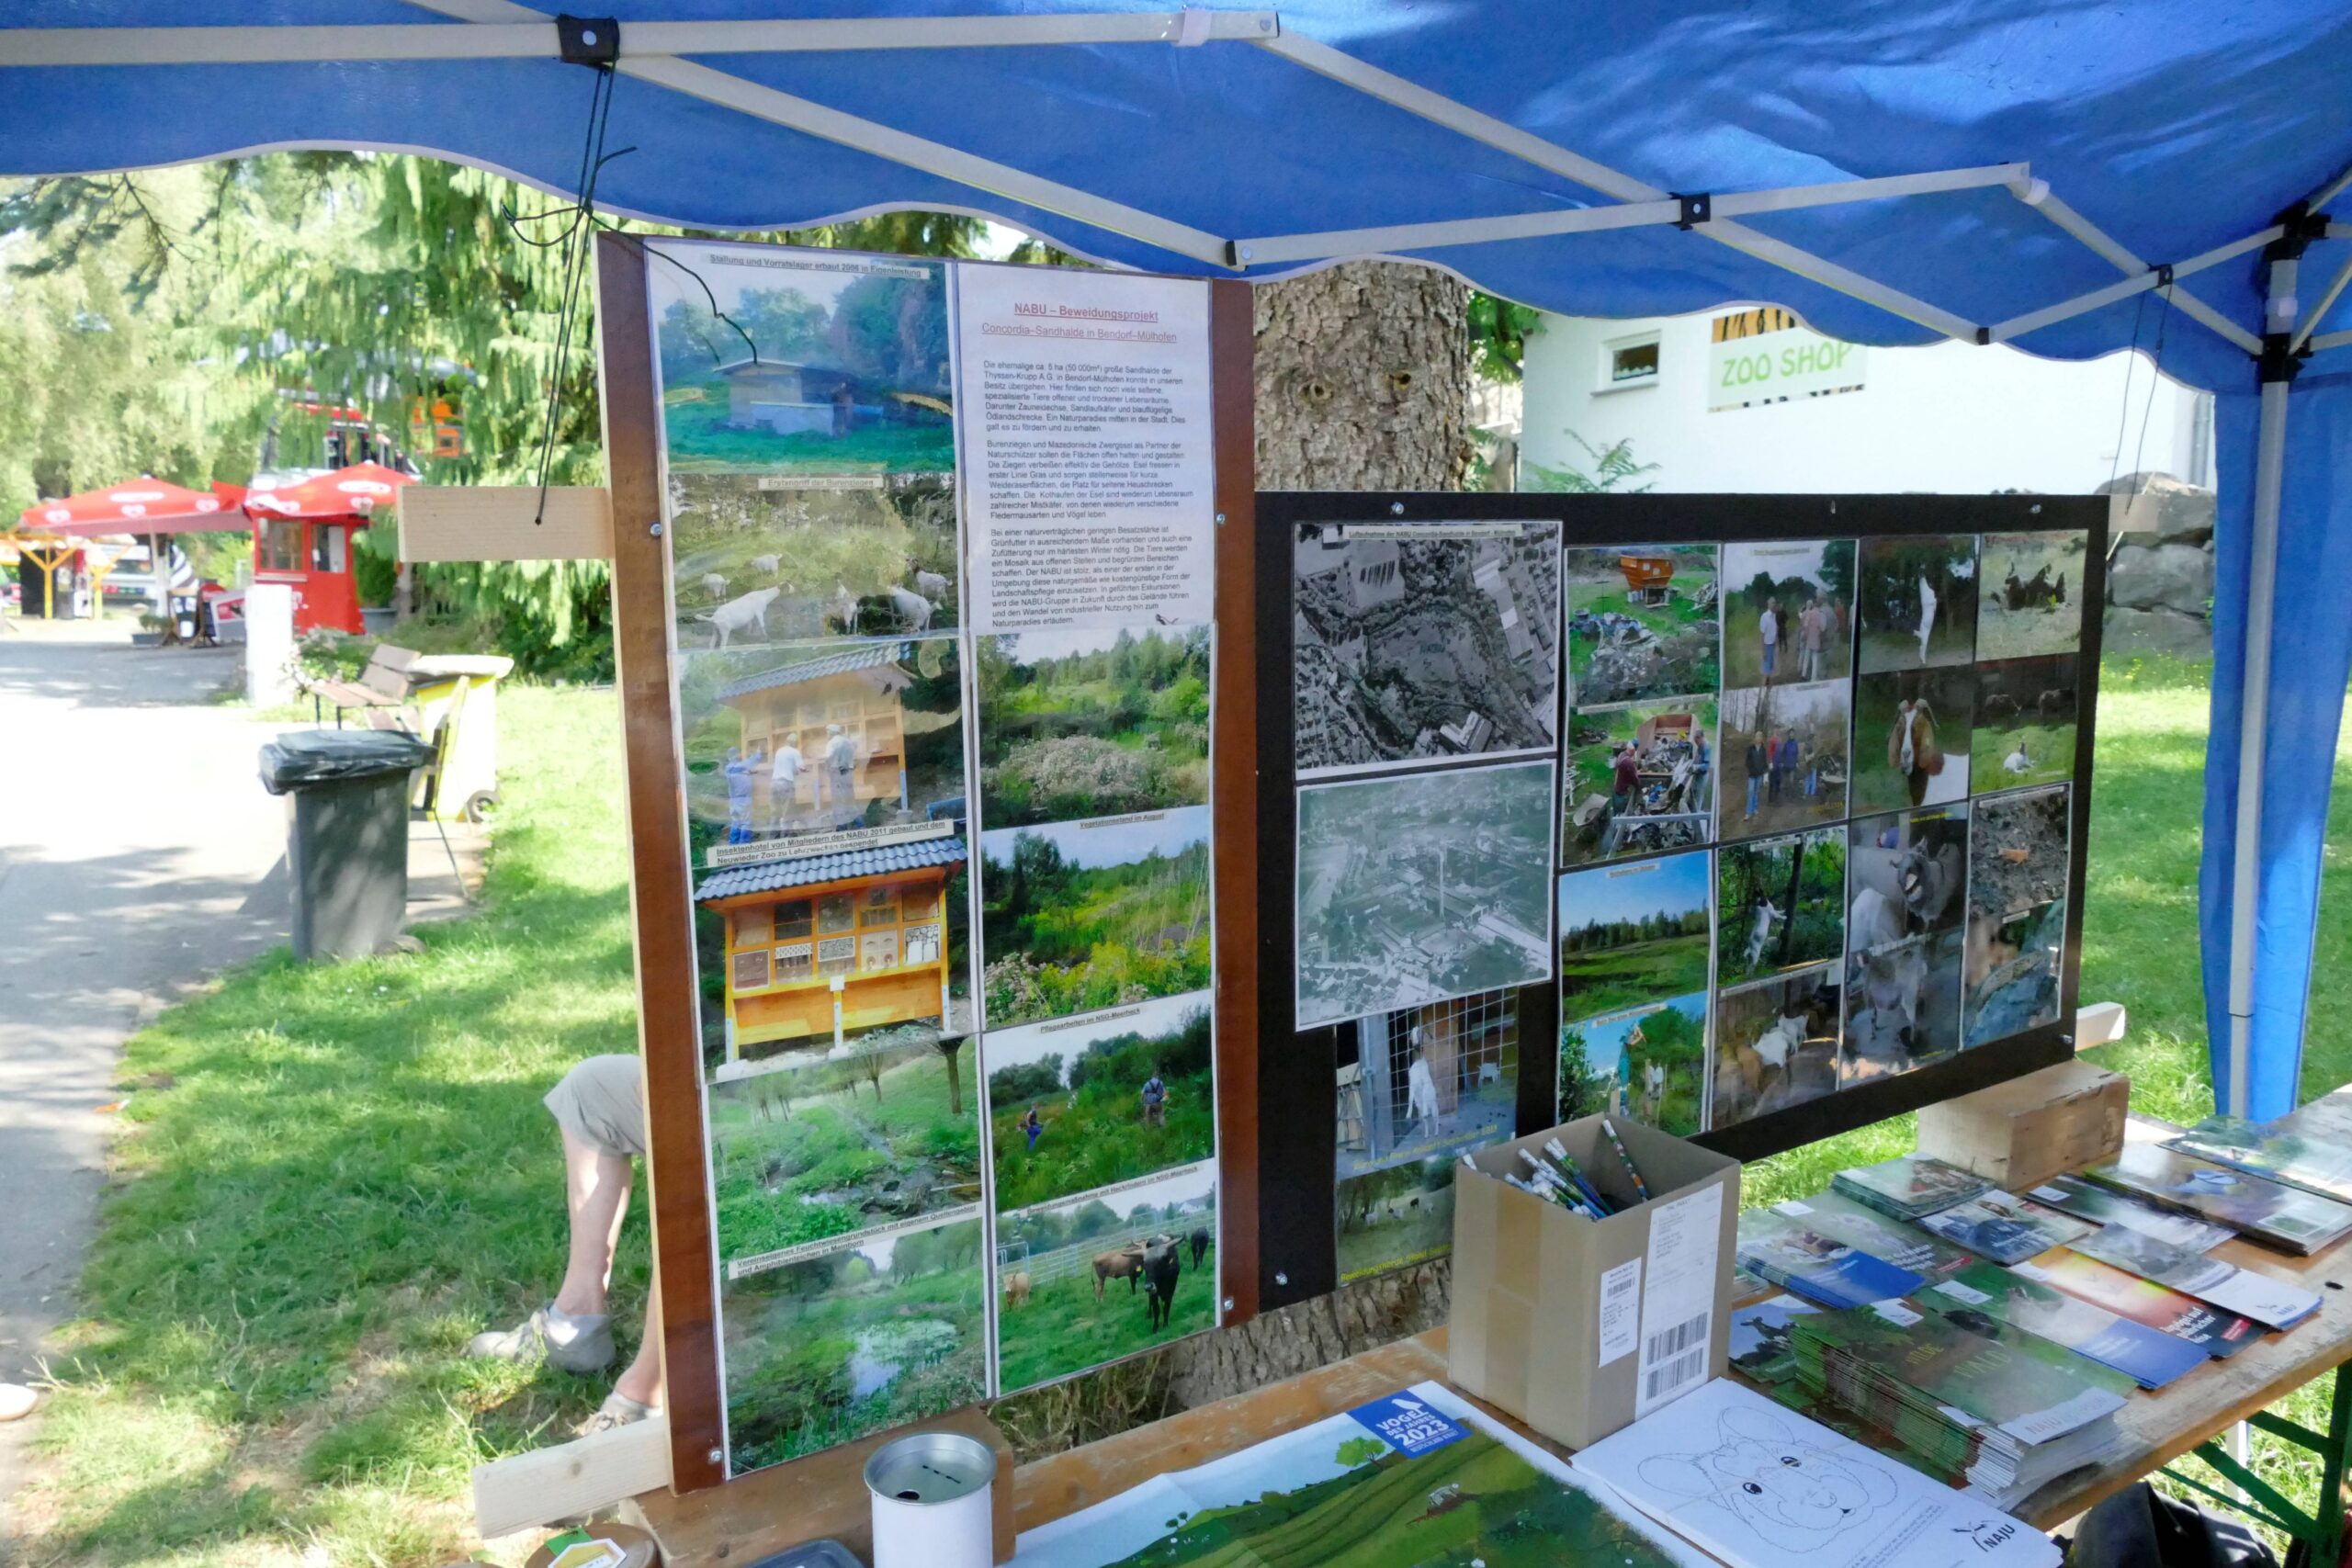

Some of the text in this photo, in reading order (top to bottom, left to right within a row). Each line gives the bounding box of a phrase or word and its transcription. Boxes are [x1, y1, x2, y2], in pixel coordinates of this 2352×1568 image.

[1015, 303, 1158, 321] NABU Beweidungsprojekt
[1721, 342, 1855, 387] ZOO SHOP
[985, 372, 1037, 381] Thyssen-Krupp
[985, 392, 1030, 400] spezialisierte
[1059, 414, 1106, 423] Naturparadies
[987, 423, 999, 432] galt
[988, 440, 1031, 449] Burenziegen
[1002, 460, 1025, 468] Ziegen
[1067, 510, 1085, 519] Vögel
[1023, 527, 1085, 536] naturverträglichen
[1087, 526, 1115, 536] geringen
[1037, 536, 1088, 545] ausreichendem
[992, 548, 1032, 557] Zufütterung
[1004, 558, 1029, 566] Mosaik
[1112, 555, 1144, 564] begrünten
[992, 579, 1030, 588] Umgebung
[1052, 576, 1096, 585] naturgemäße
[1112, 574, 1159, 582] kostengünstige
[992, 587, 1055, 596] Landschaftspflege
[1108, 584, 1139, 593] geführten
[1021, 597, 1069, 605] NABU-Gruppe
[1023, 604, 1131, 615] Wandel industrieller Nutzung
[993, 617, 1040, 627] Naturparadies
[1376, 1408, 1429, 1430] VOGEL
[1386, 1415, 1436, 1436] DES JAHRES
[1394, 1419, 1450, 1446] 2023
[1983, 1523, 2016, 1549] NAJU
